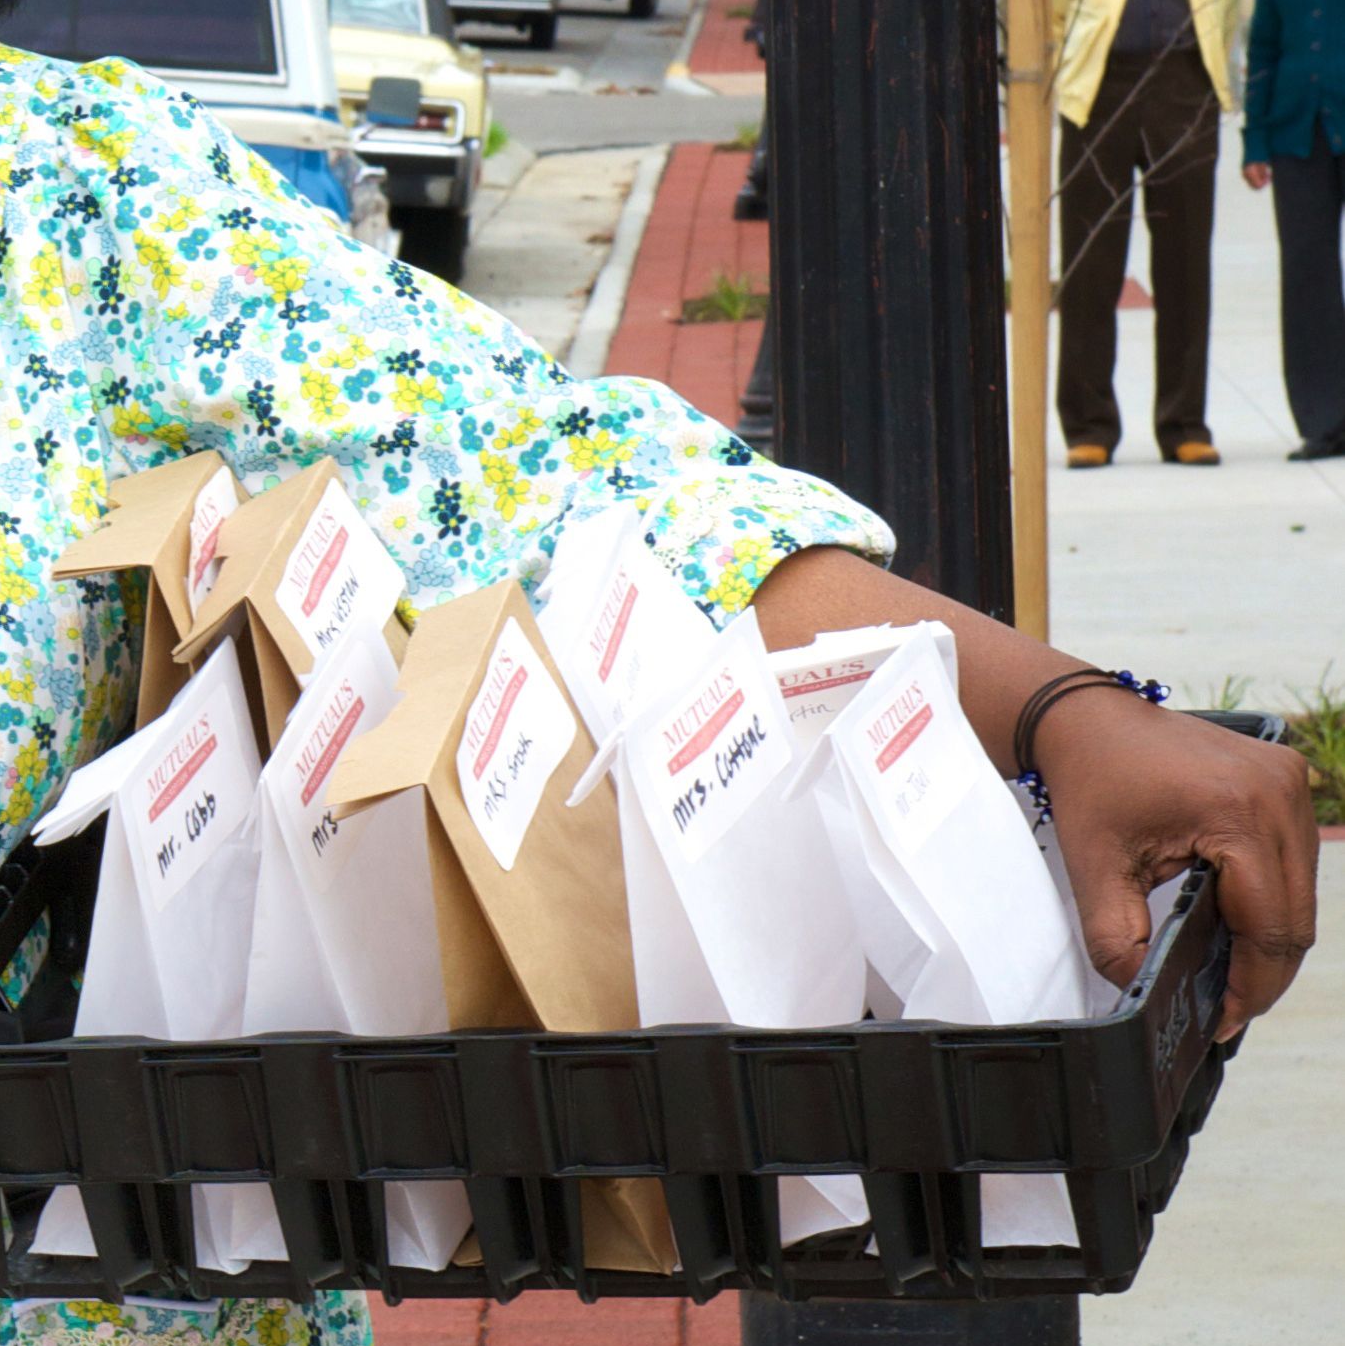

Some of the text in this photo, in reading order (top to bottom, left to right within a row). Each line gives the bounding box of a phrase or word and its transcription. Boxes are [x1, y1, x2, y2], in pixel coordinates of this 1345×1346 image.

[779, 659, 865, 687] UAL'S
[295, 678, 354, 783] MUTUAL'S
[662, 666, 735, 752] MUTUAL'S
[789, 703, 835, 724] rtin
[147, 713, 210, 799] MUTUAL'S
[185, 790, 216, 842] Cobb
